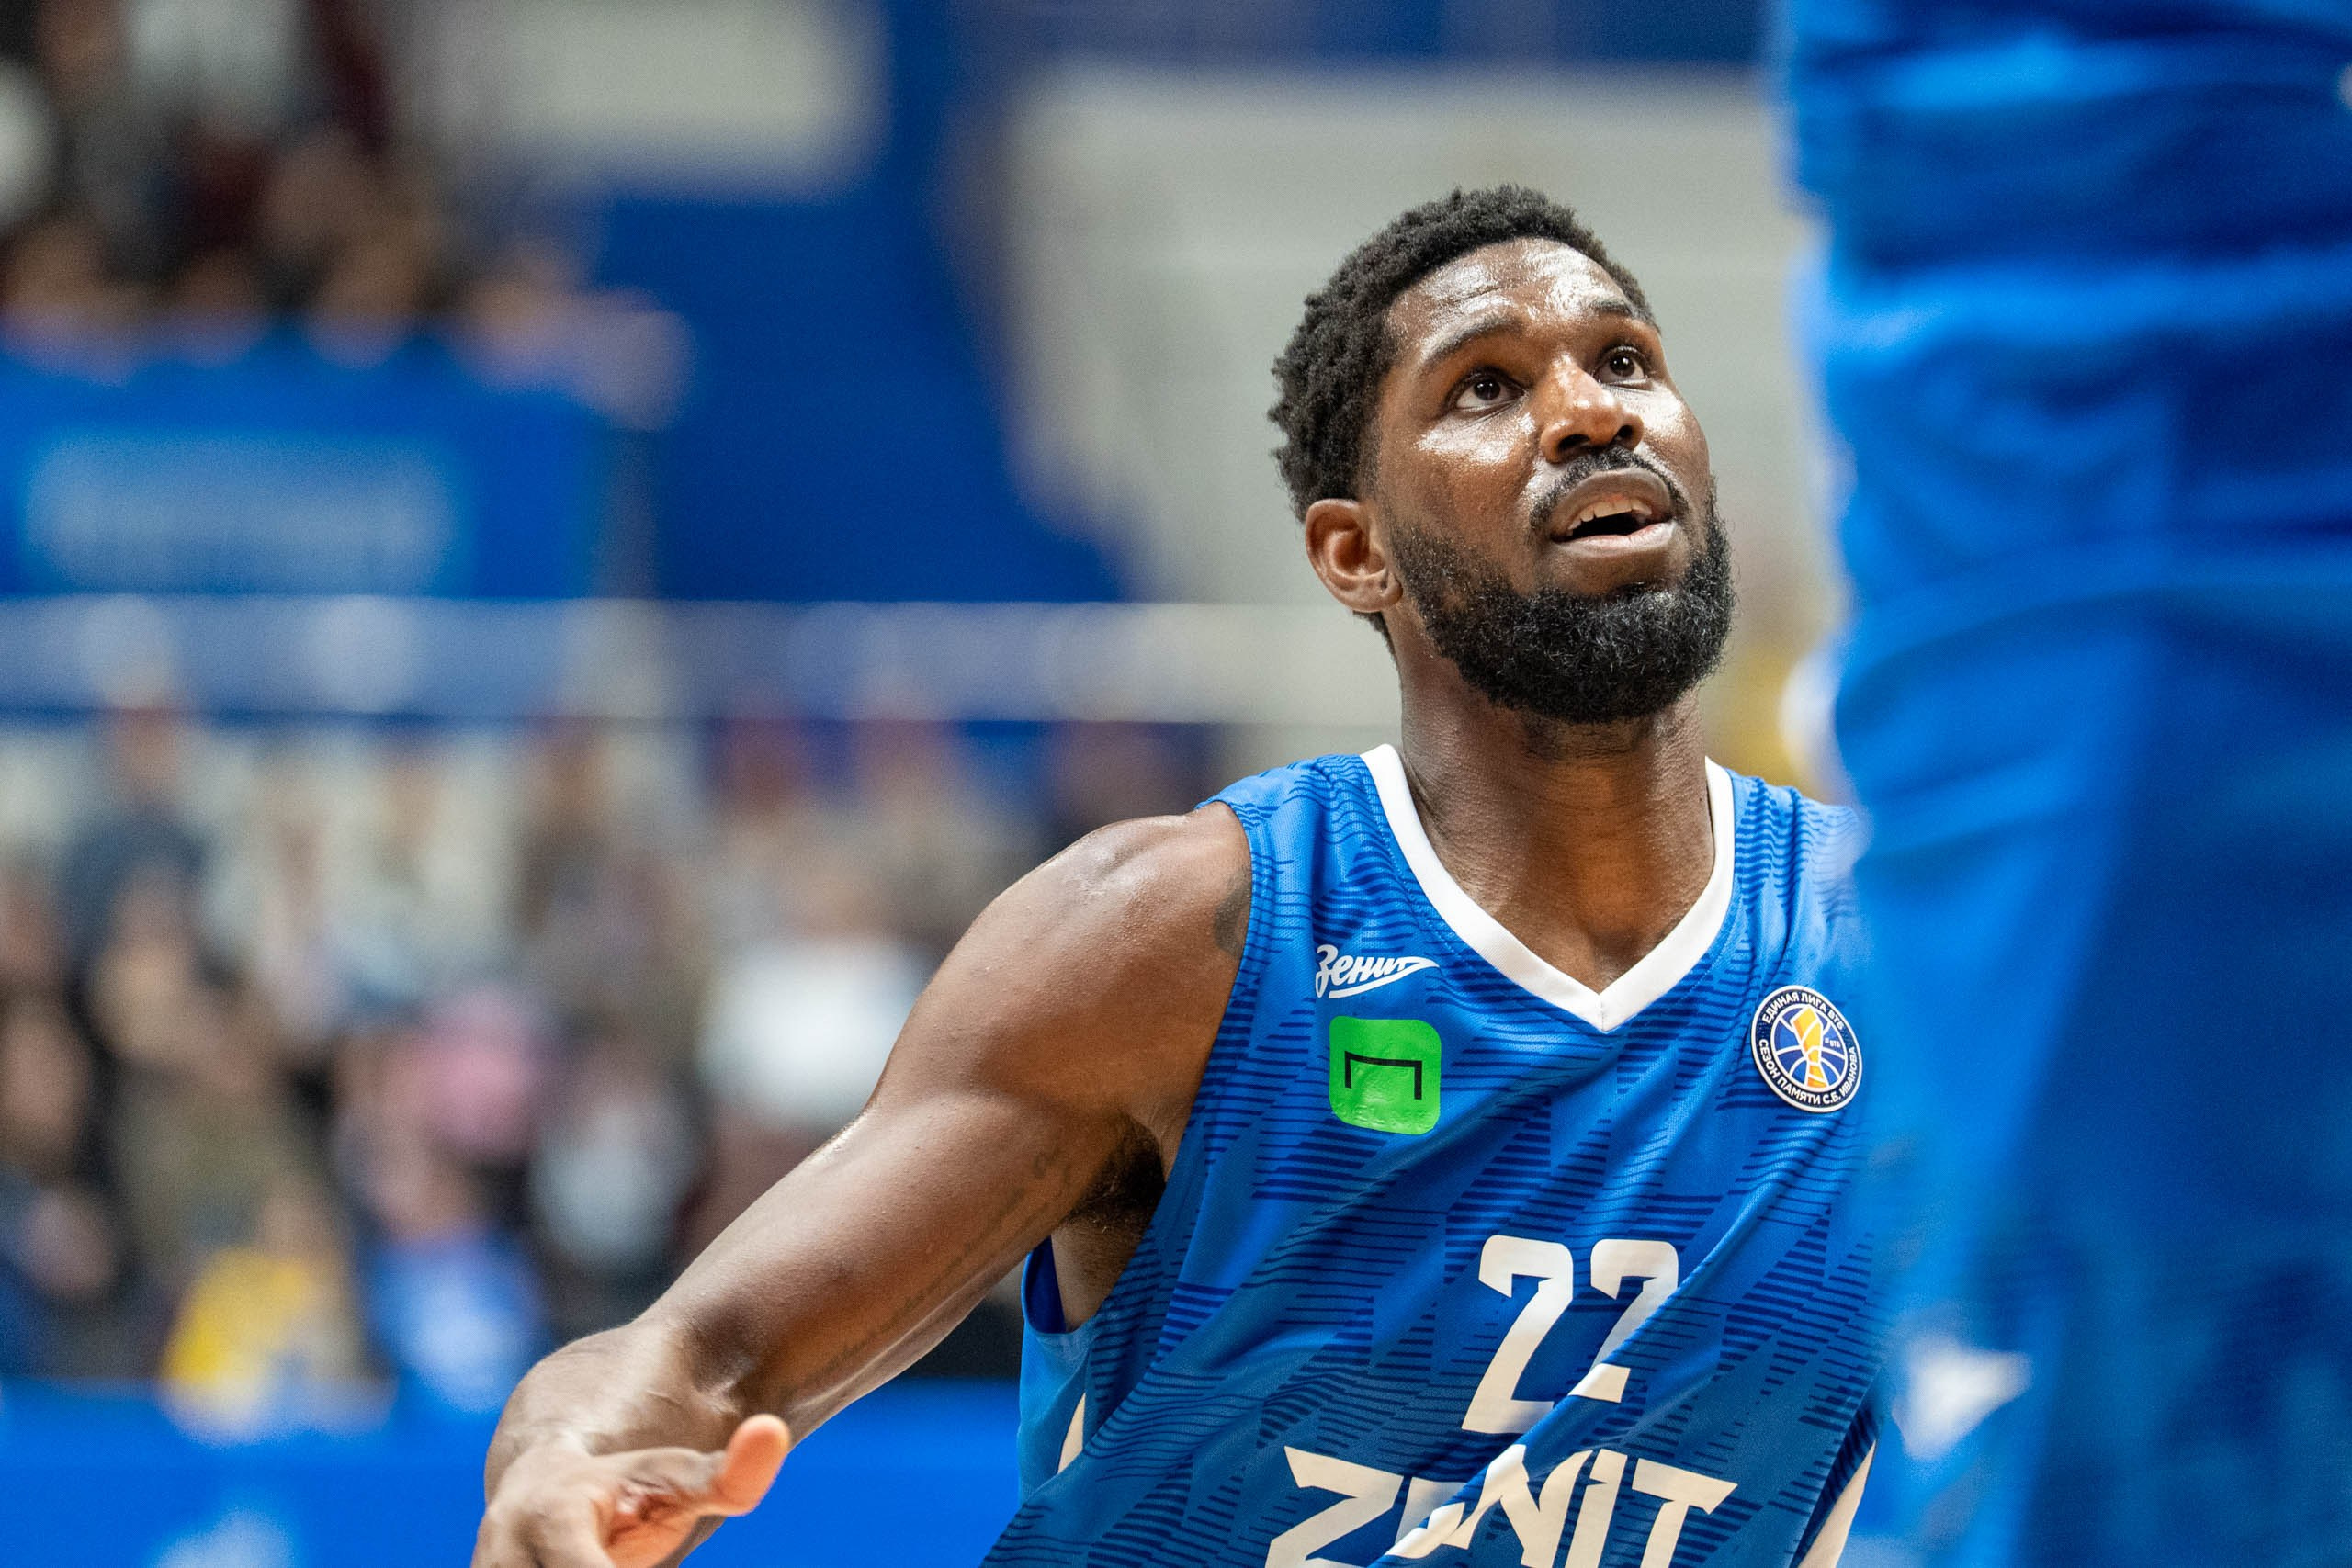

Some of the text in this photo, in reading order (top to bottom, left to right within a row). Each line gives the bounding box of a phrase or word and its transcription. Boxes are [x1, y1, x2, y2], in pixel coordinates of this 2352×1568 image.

[1762, 992, 1845, 1031] ЕДИНАЯ ЛИГА ВТБ
[1758, 1039, 1781, 1077] СЕЗОН
[1777, 1077, 1821, 1105] ПАМЯТИ
[1839, 1046, 1857, 1097] ИВАНОВА
[1462, 1235, 1679, 1434] 22
